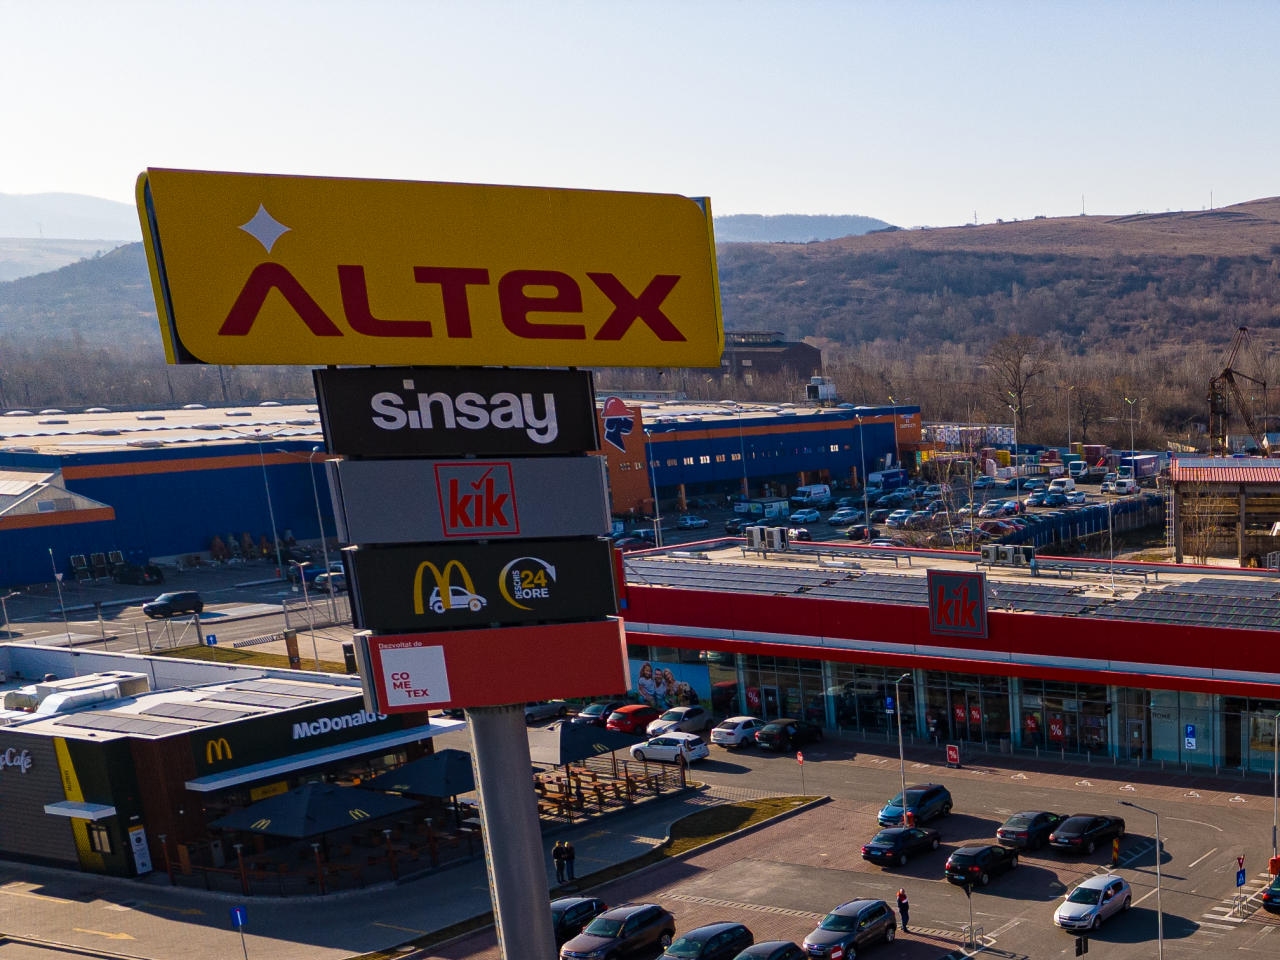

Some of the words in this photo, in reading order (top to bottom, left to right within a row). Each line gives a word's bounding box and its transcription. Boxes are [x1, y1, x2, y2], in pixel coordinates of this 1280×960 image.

[371, 379, 559, 444] sinsay
[512, 570, 523, 599] DESCHIS
[521, 570, 547, 588] 24
[522, 588, 549, 599] ORE
[391, 672, 410, 681] CO
[392, 681, 412, 690] ME
[405, 689, 429, 698] TEX
[293, 709, 388, 739] McDonalds
[0, 747, 32, 773] cCafé
